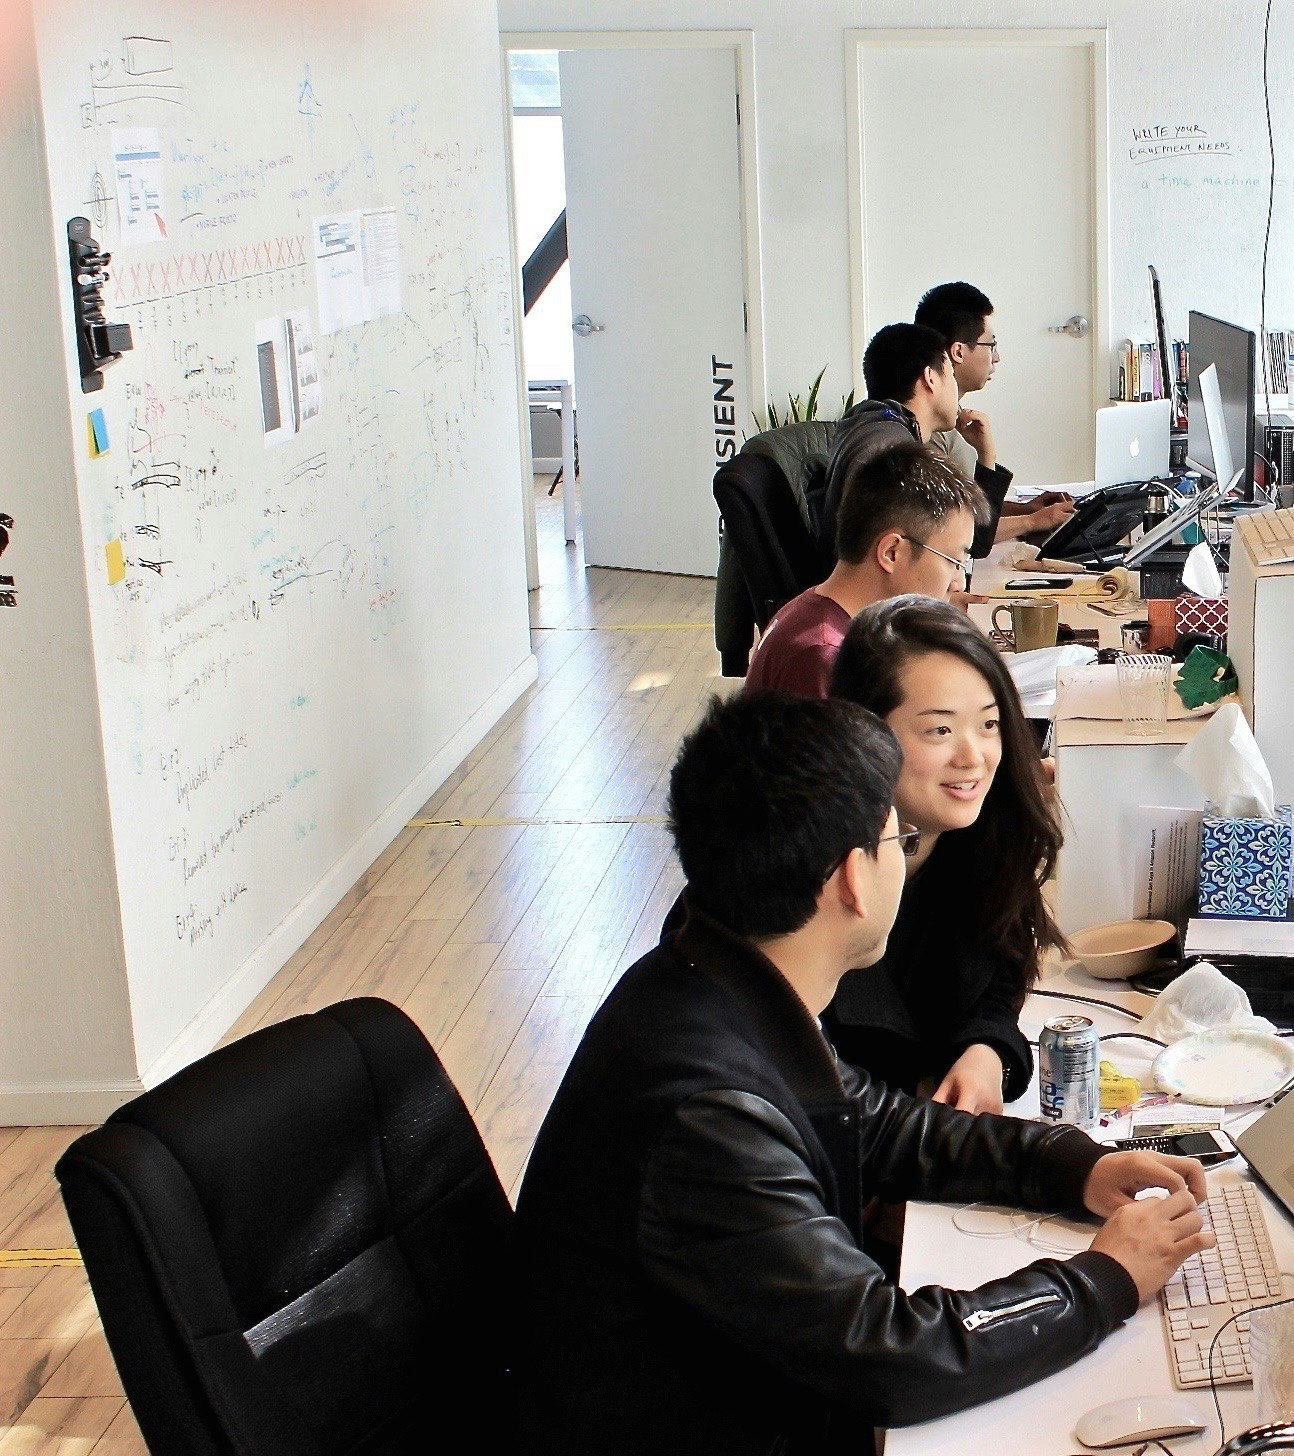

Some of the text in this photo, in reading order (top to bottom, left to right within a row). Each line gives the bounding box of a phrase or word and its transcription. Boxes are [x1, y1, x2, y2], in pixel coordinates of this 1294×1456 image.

[1132, 124, 1207, 141] WRITE YOUR
[1198, 142, 1230, 151] NEEDS
[1158, 173, 1193, 187] time
[1203, 174, 1260, 187] machine
[712, 355, 736, 543] SIENT
